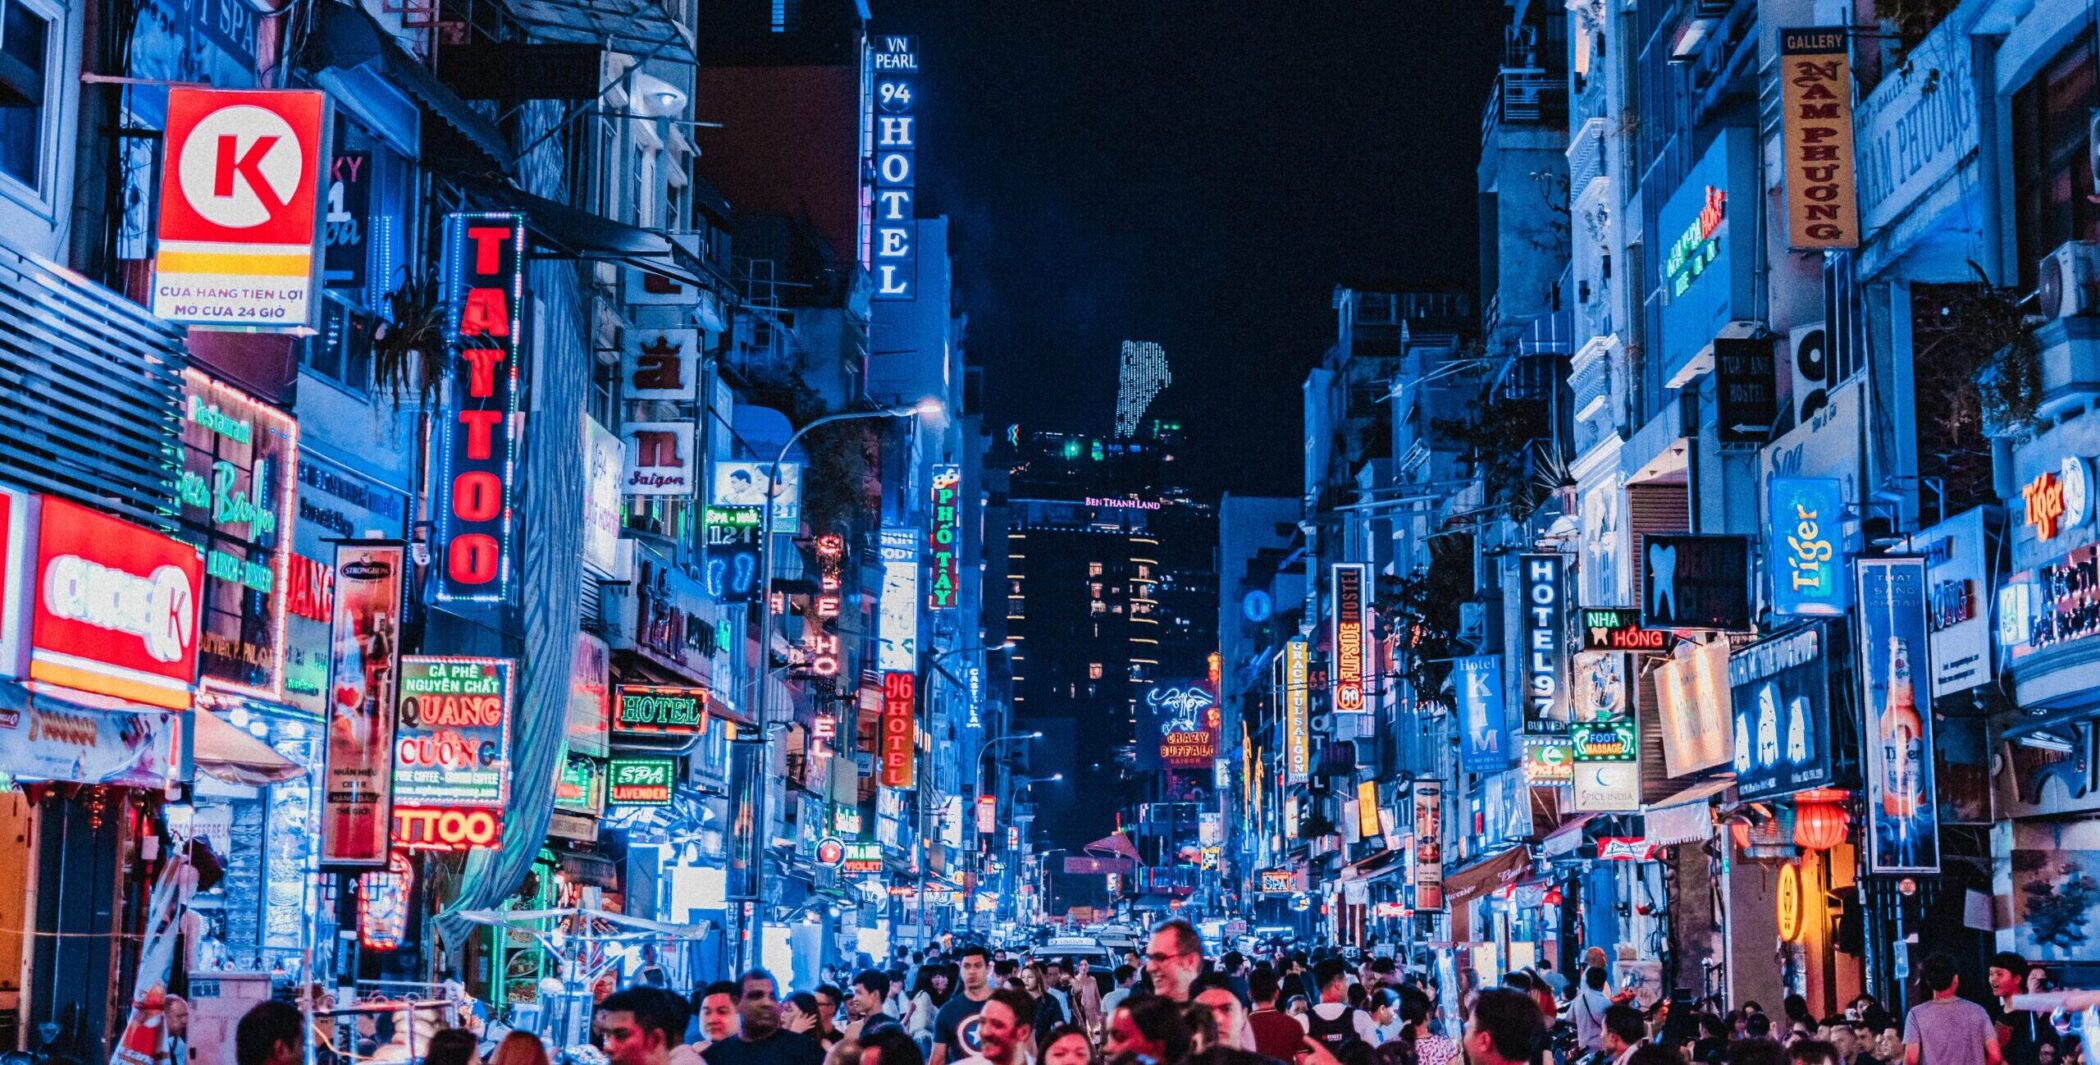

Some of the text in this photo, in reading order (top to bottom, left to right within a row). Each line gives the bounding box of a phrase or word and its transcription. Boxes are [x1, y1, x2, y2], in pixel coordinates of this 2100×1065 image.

[888, 38, 907, 51] VN
[1787, 35, 1843, 48] GALLERY
[876, 54, 917, 69] PEARL
[880, 83, 910, 103] 94
[880, 117, 912, 294] HOTEL
[237, 306, 256, 318] 24
[449, 227, 511, 584] TATTOO
[628, 471, 685, 488] Saigon
[1104, 498, 1135, 508] THANH
[1137, 500, 1160, 510] LAND
[2022, 472, 2064, 540] Tiger
[1787, 503, 1833, 592] Tiger
[1588, 612, 1619, 627] NHA
[1460, 657, 1496, 672] Hotel
[885, 673, 913, 699] 96
[401, 695, 502, 728] QUANG
[621, 696, 701, 725] HOTEL
[1467, 672, 1500, 755] KIM
[888, 701, 907, 784] HOTEL
[1167, 732, 1210, 744] CRAZY
[1590, 733, 1617, 743] FOOT
[618, 766, 665, 784] SPA
[613, 785, 668, 801] LAVENDER
[1607, 792, 1634, 801] INDIA
[394, 809, 496, 843] TTOO
